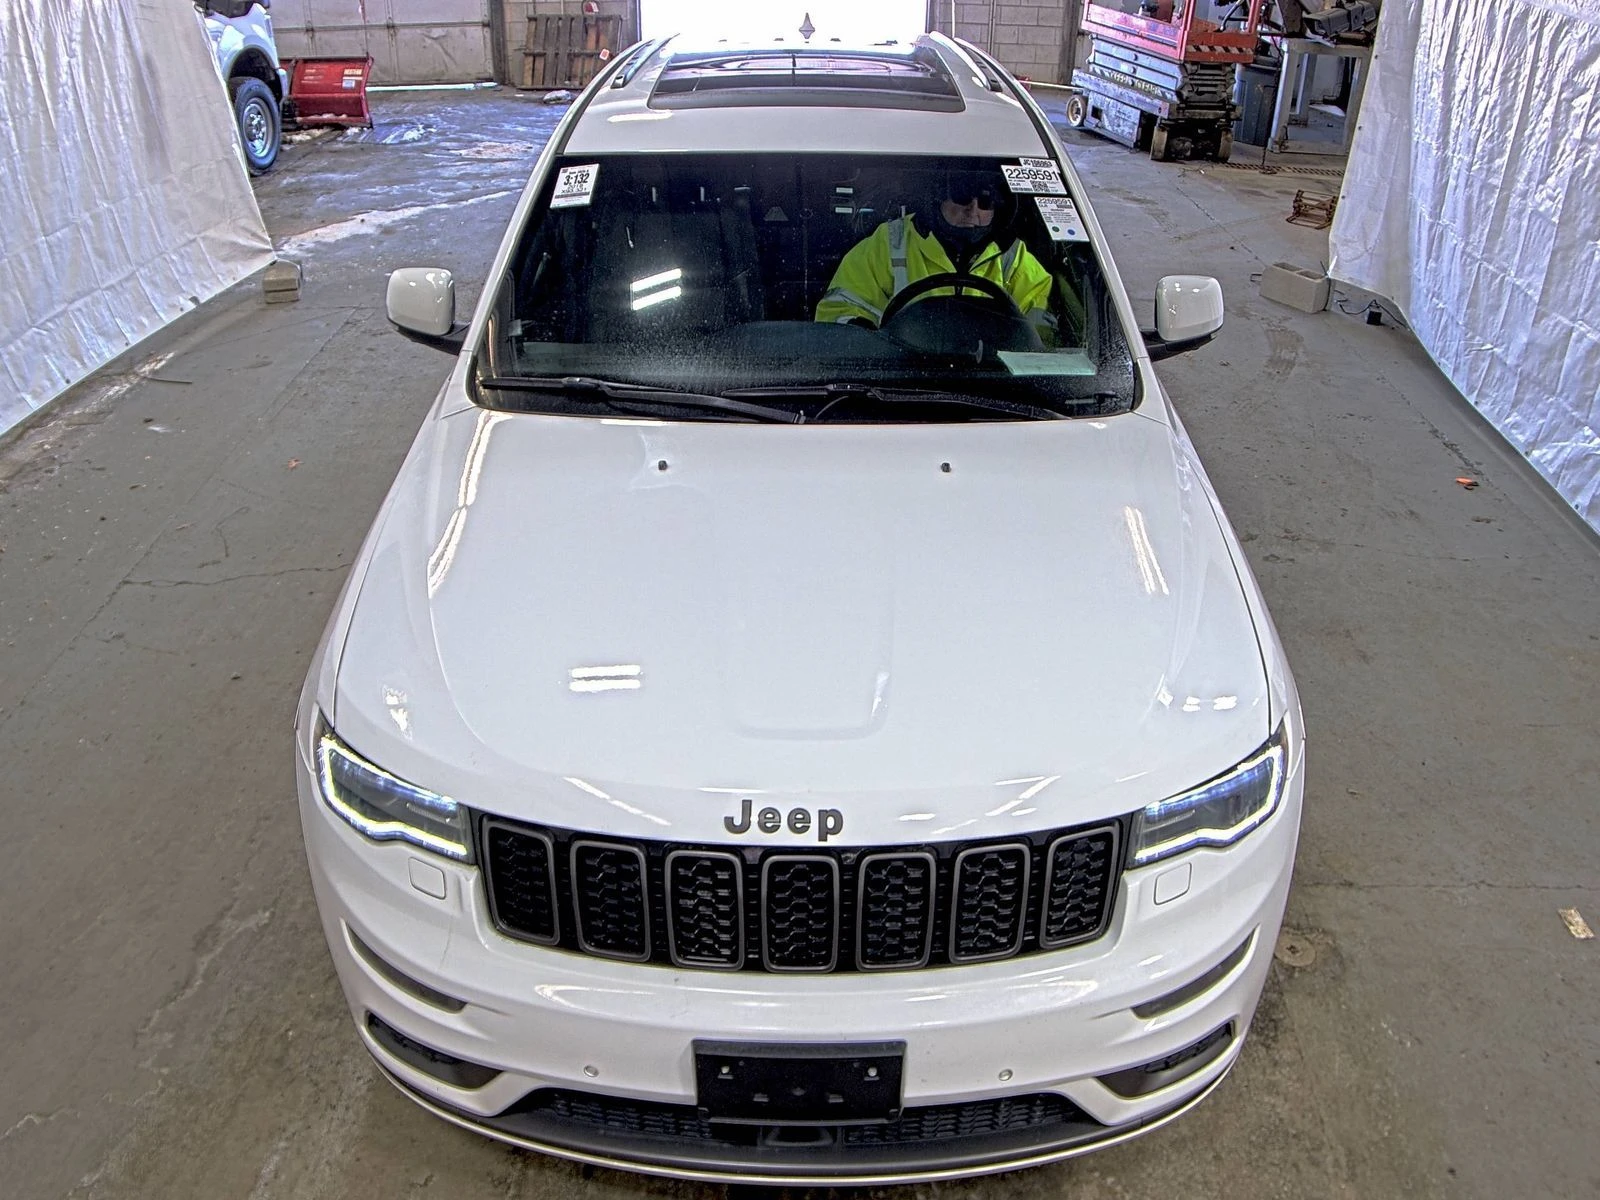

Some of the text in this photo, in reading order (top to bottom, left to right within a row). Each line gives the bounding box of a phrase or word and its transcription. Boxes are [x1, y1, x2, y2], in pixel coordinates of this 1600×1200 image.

[564, 173, 590, 185] 3:132
[1006, 168, 1059, 181] 2259591
[724, 799, 844, 842] Jeep
